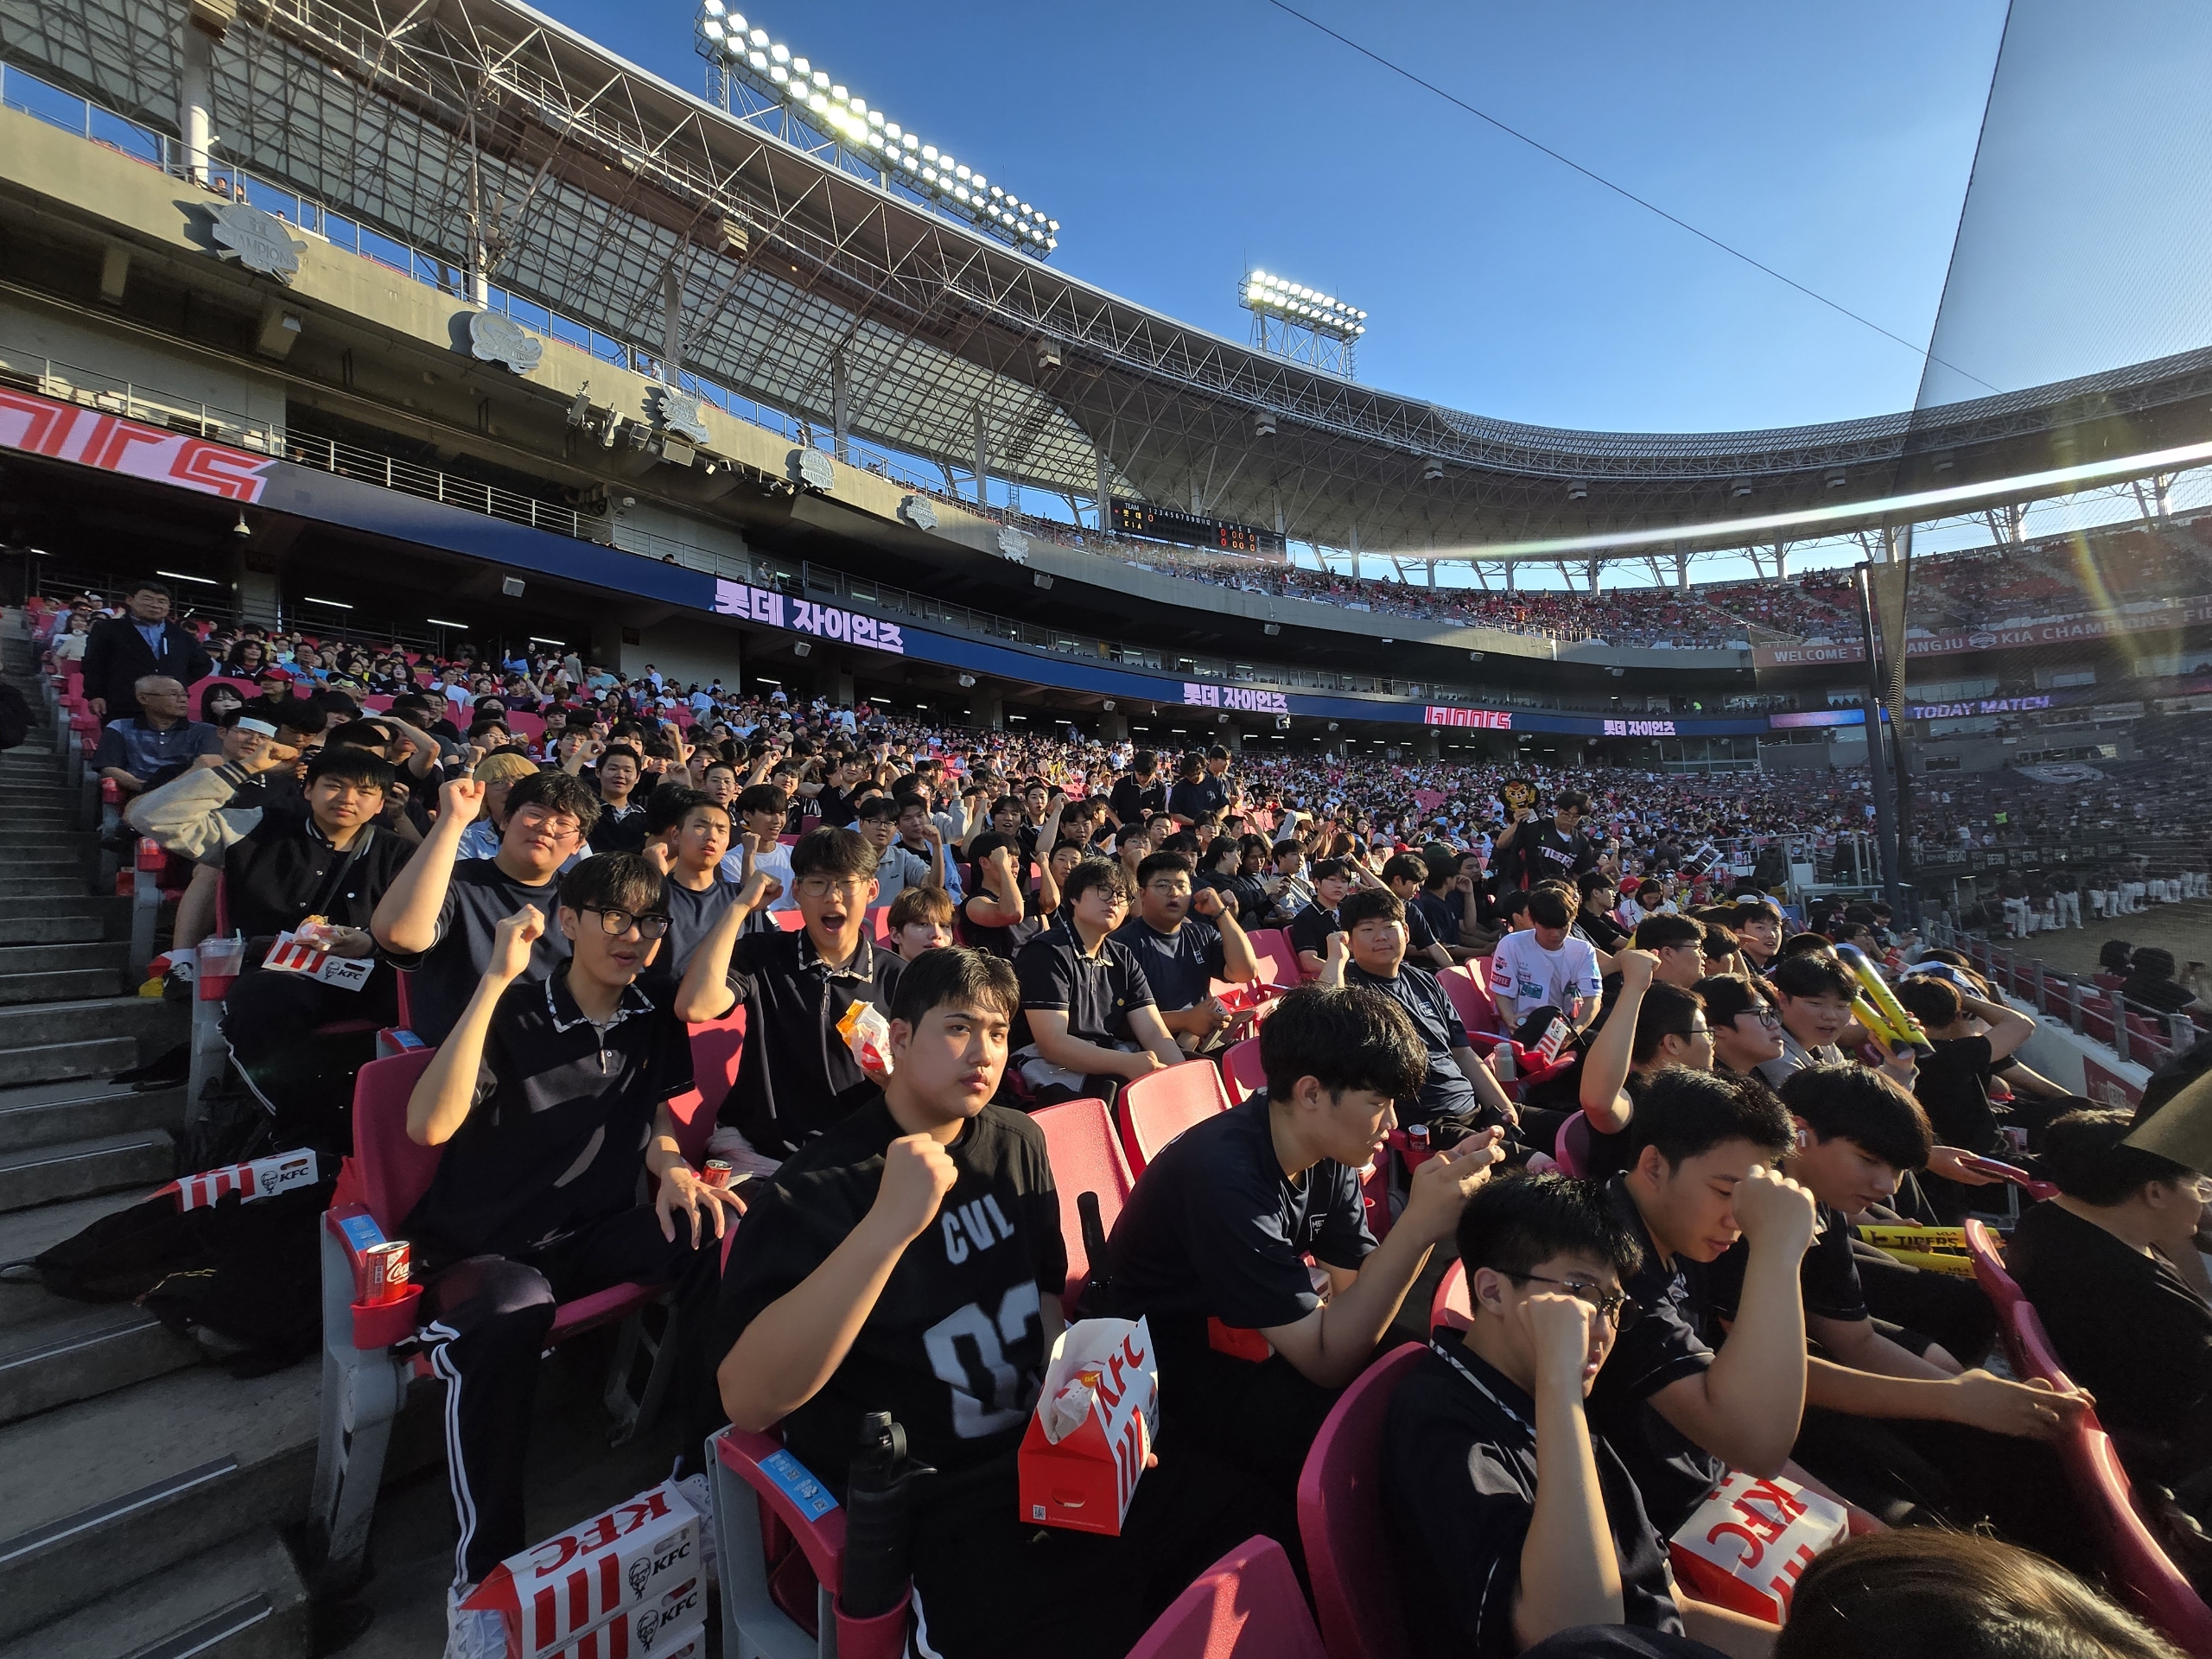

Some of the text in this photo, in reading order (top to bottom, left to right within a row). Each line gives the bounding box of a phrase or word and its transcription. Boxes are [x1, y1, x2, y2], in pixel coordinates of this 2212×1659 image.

[1125, 502, 1140, 511] TEAM
[1124, 520, 1142, 530] KIA
[715, 579, 904, 654] 롯데 자이언츠
[1774, 648, 1847, 662] WELCOME
[2001, 631, 2034, 645] KIA
[2043, 613, 2170, 639] CHAMPIONS
[1183, 683, 1287, 714] 롯데 자이언츠
[1913, 702, 1975, 719] TODAY
[1604, 720, 1676, 736] 롯데 자이언츠
[337, 969, 362, 981] KFC
[279, 1166, 309, 1183] KFC
[941, 1193, 1014, 1265] CVL
[1095, 1333, 1145, 1429] KFC
[529, 1491, 672, 1579] KFC
[1706, 1478, 1809, 1570] KFC
[652, 1541, 690, 1576] KFC
[659, 1592, 698, 1628] KFC
